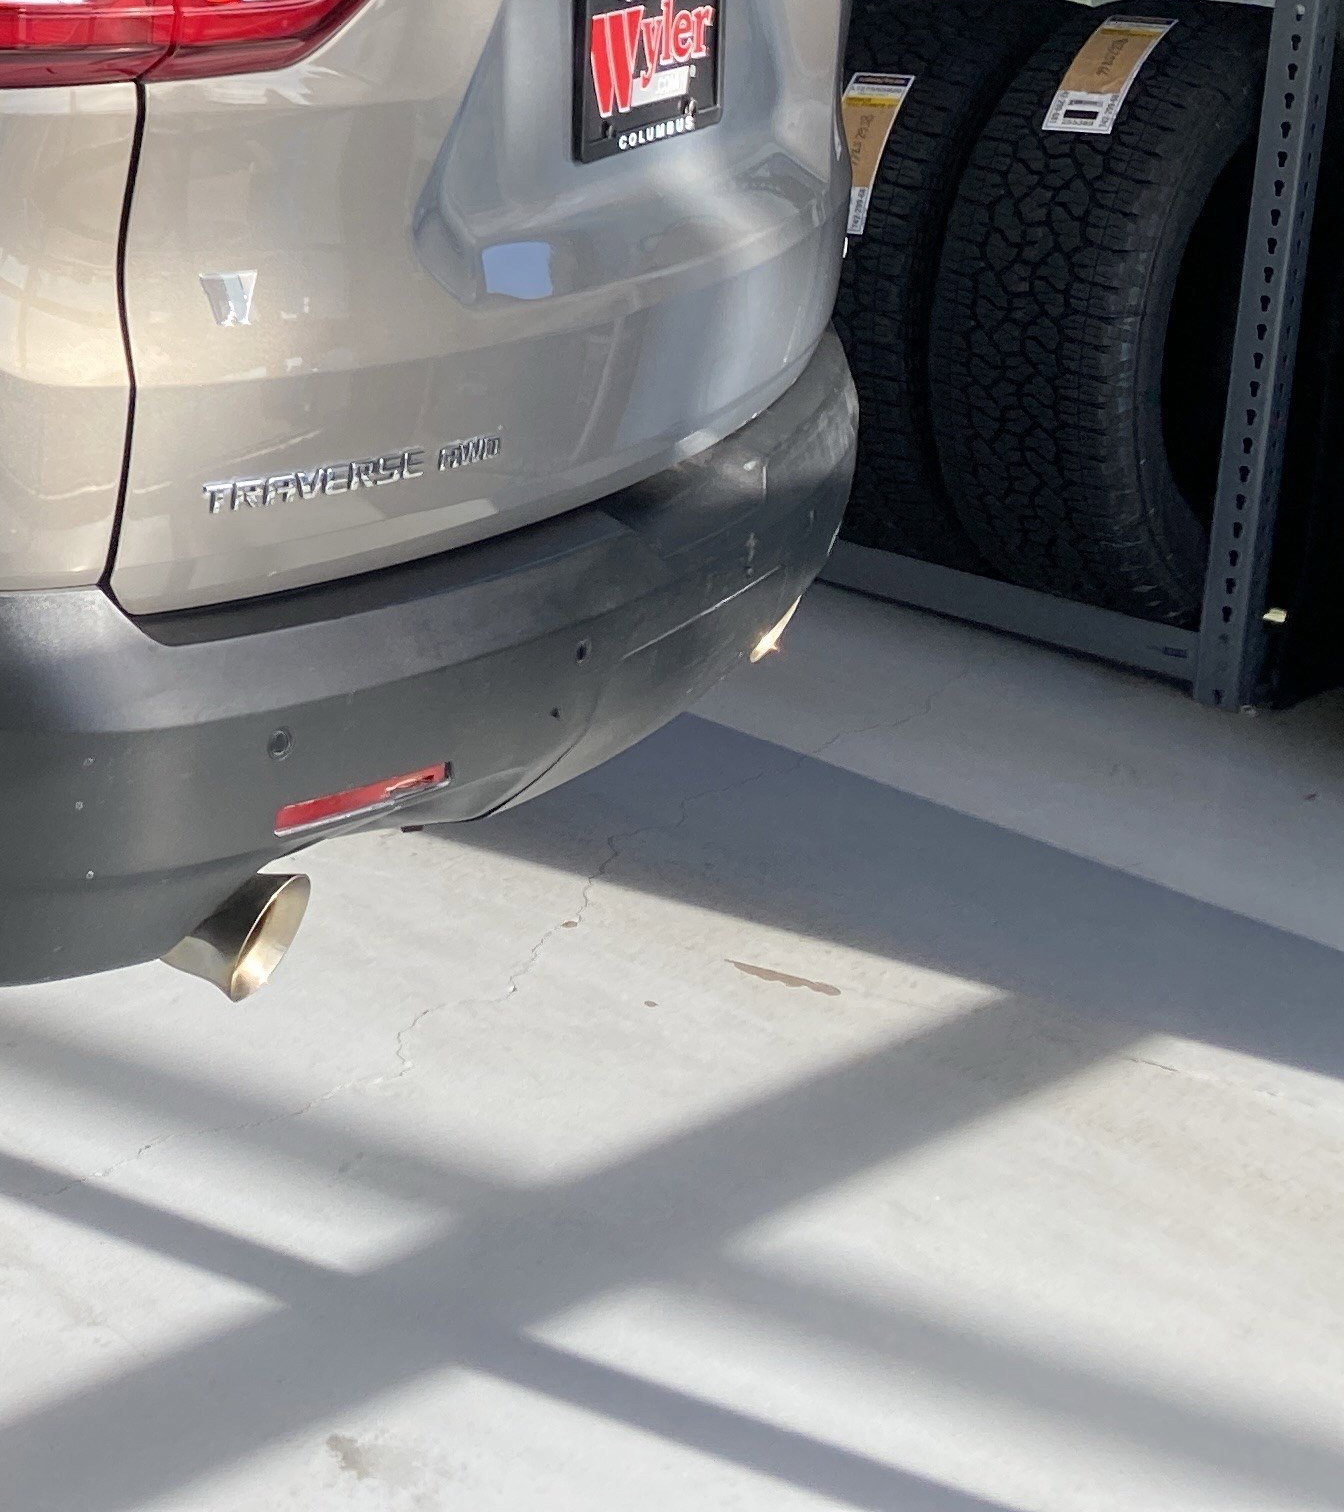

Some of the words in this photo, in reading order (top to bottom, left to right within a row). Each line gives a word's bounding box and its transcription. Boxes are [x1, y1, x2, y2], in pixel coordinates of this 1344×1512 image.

[618, 115, 696, 150] COLUMBUS
[201, 445, 425, 515] TRAVERSE
[437, 434, 501, 473] AWD
